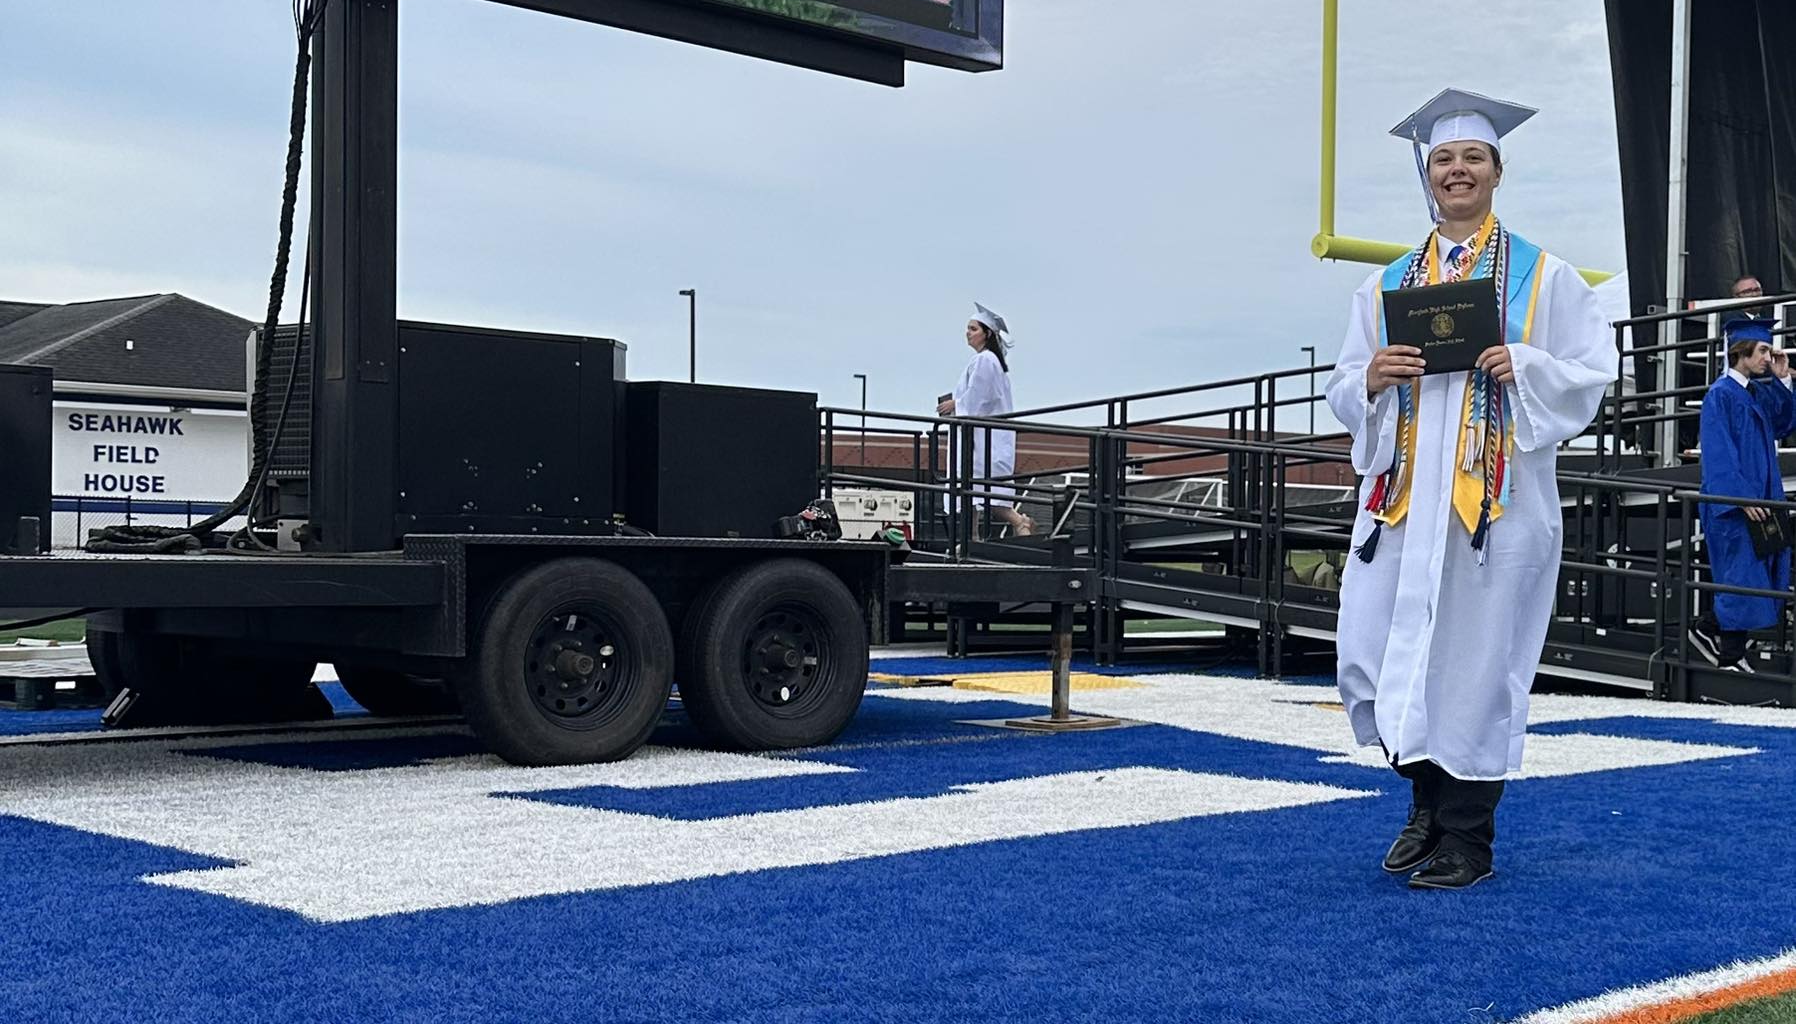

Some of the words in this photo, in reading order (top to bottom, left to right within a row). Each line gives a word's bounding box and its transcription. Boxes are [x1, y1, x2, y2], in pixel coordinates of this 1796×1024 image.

[68, 413, 184, 435] SEAHAWK
[93, 445, 160, 464] FIELD
[84, 474, 165, 493] HOUSE
